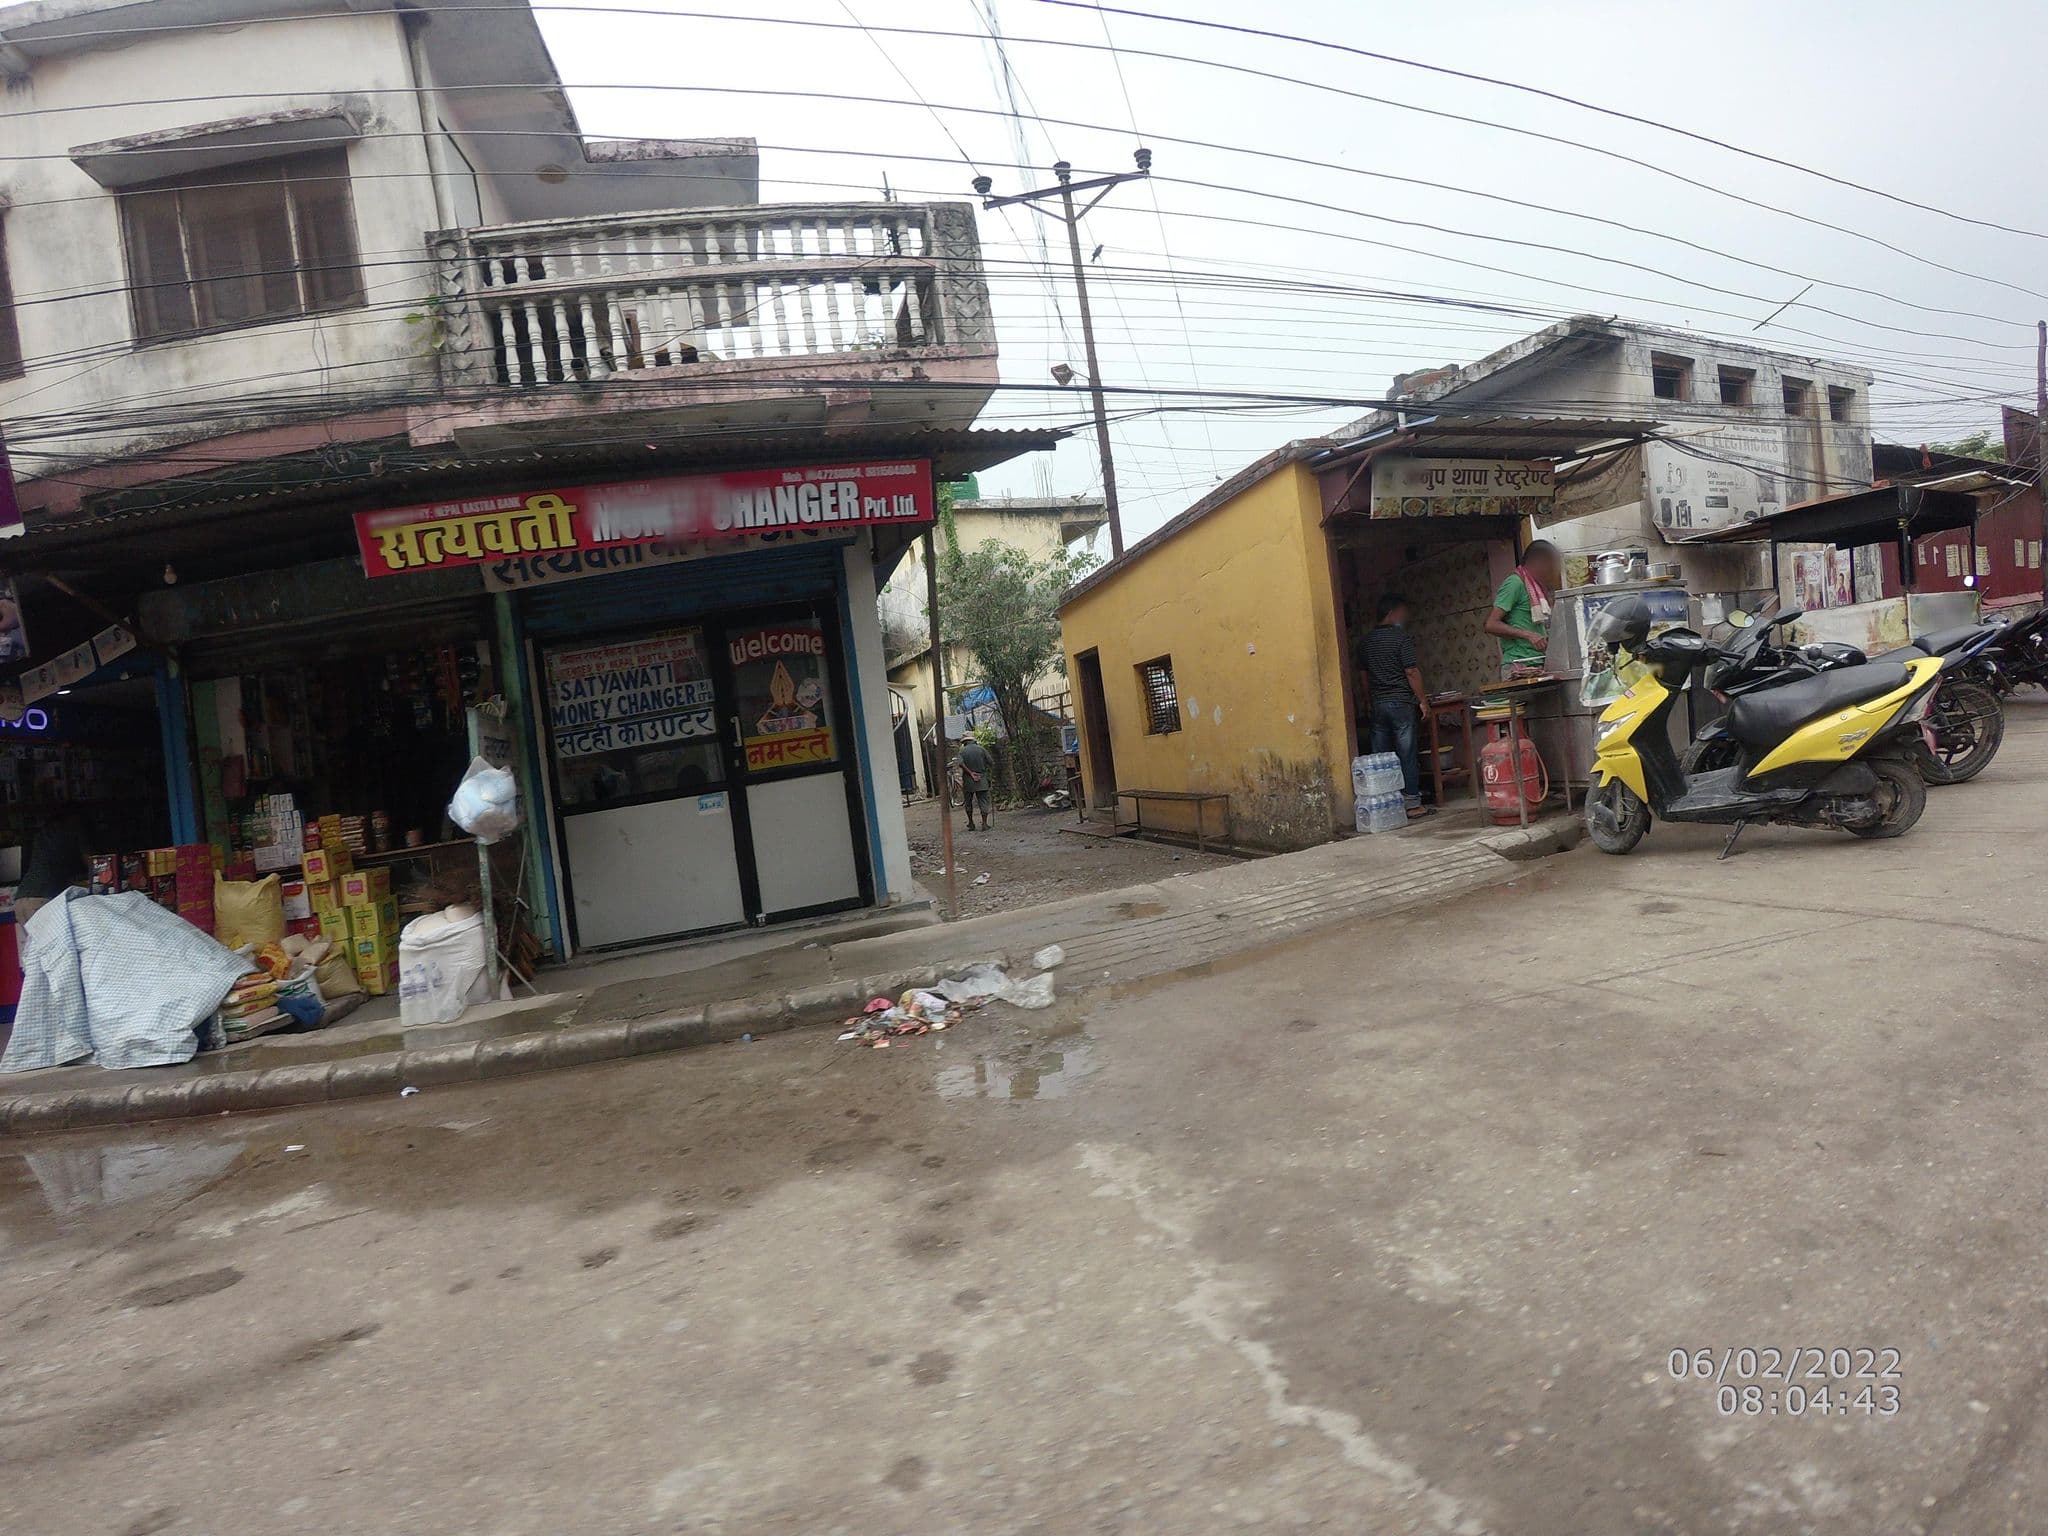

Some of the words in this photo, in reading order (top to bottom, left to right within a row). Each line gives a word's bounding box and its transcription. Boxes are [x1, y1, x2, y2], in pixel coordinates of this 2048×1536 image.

[1451, 467, 1489, 486] थापा
[864, 496, 891, 519] Pvt.
[893, 494, 919, 516] Ltd.
[370, 493, 578, 570] सत्यवती
[729, 631, 824, 665] Welcome
[559, 663, 675, 702] SATYAWATI
[551, 697, 612, 727] MONEY
[617, 685, 697, 716] CHANGER
[556, 723, 614, 756] सटही
[746, 728, 830, 765] नमस्ते
